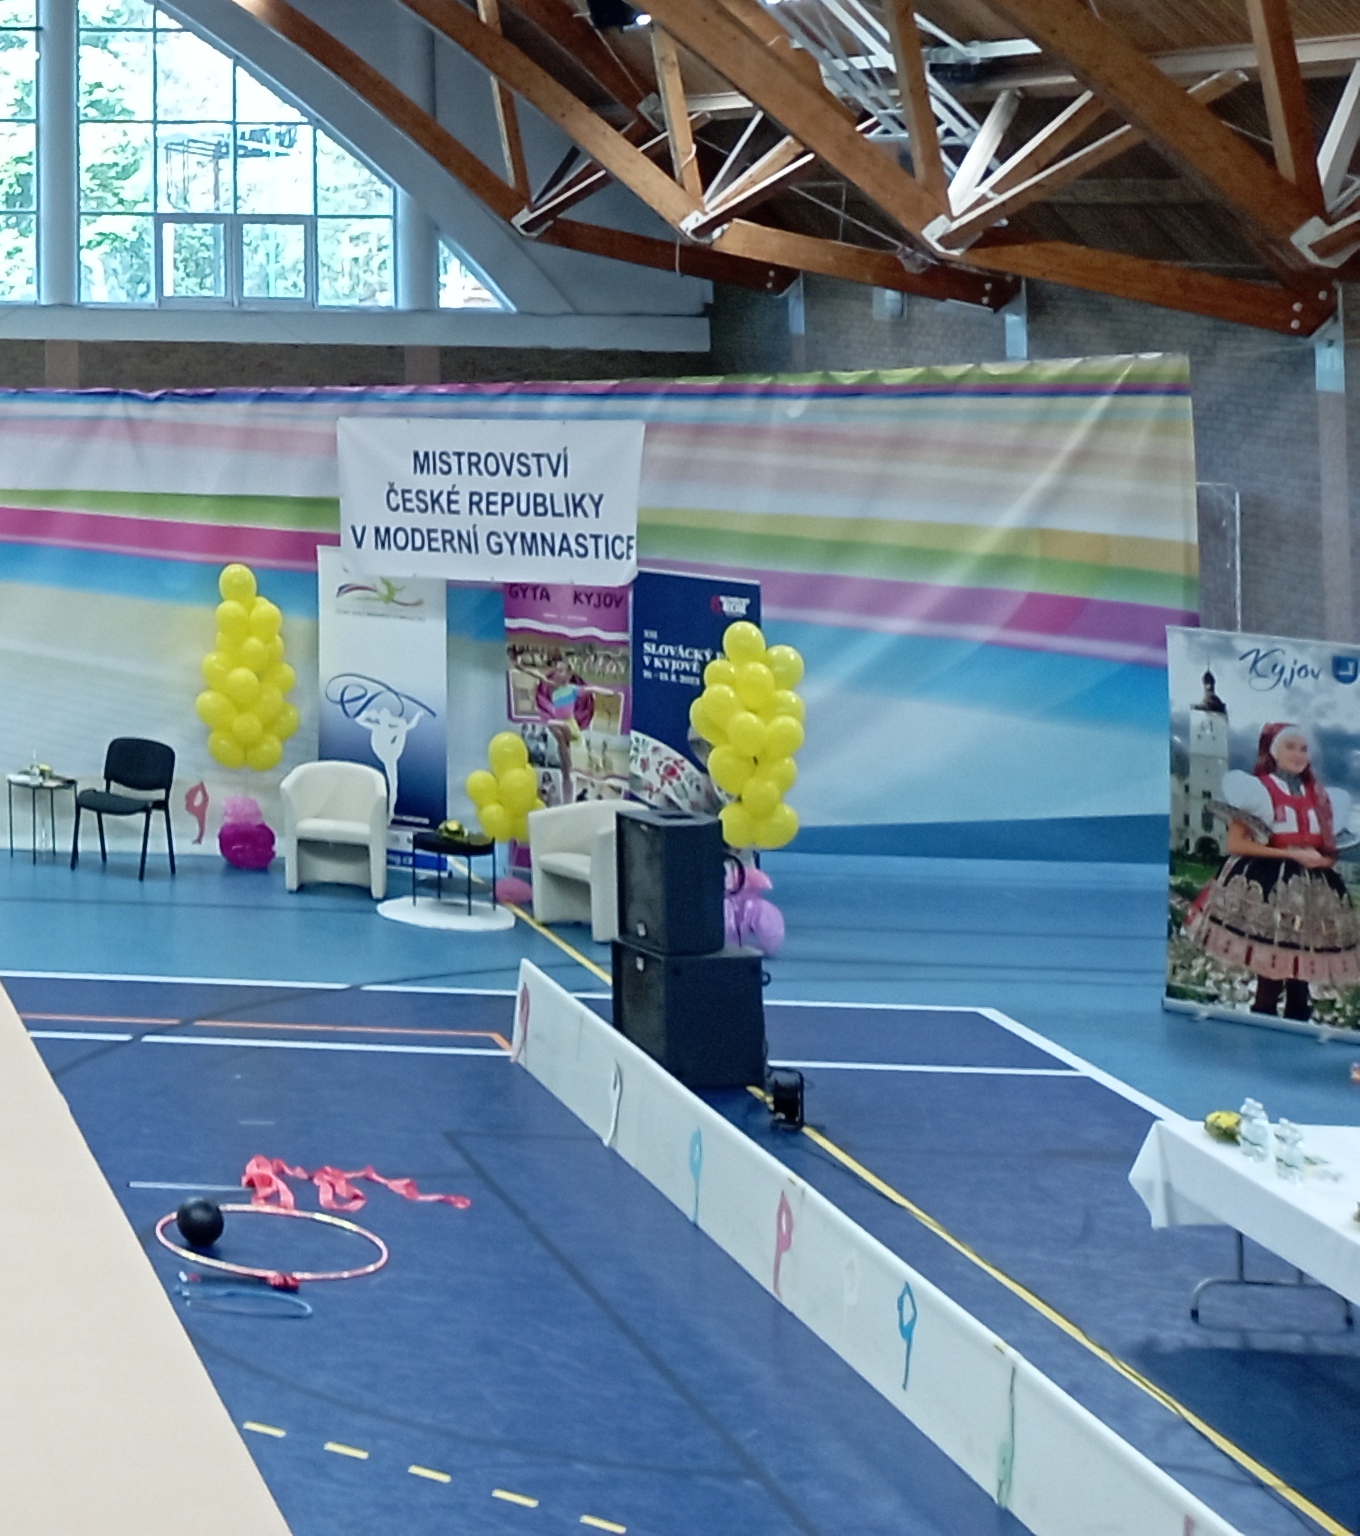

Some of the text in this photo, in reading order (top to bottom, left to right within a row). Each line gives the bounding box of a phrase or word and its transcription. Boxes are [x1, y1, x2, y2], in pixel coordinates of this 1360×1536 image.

[412, 446, 568, 478] MISTROVSTVÍ
[386, 481, 604, 519] ČESKÉ REPUBLIKY
[350, 524, 367, 549] V
[374, 523, 479, 555] MODERNÍ
[508, 584, 623, 609] GYTA KYJOV
[1239, 648, 1320, 692] Kyjov
